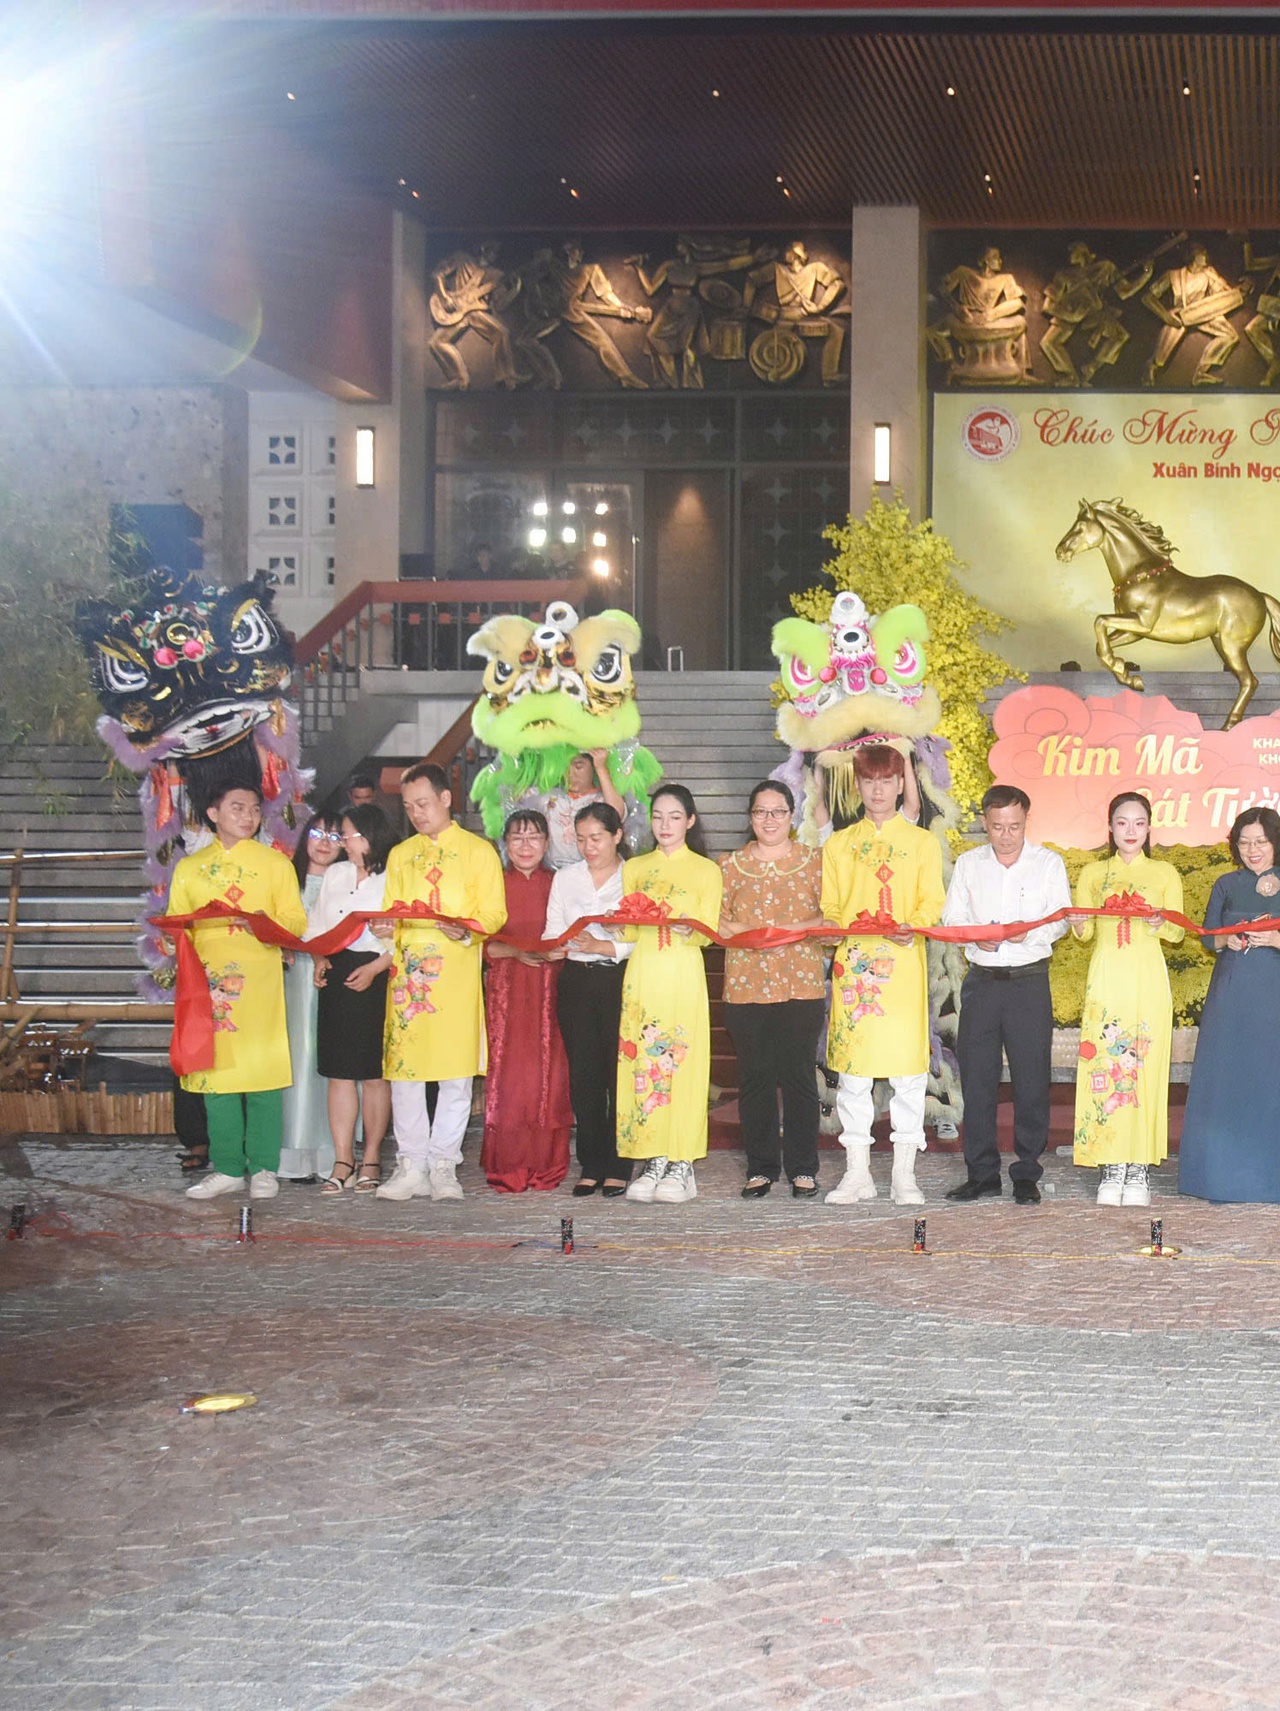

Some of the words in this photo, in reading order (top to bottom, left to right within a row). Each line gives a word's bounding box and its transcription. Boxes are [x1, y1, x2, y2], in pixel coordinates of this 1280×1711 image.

[1033, 407, 1115, 447] Chúc
[1122, 409, 1239, 460] Mừng
[1152, 462, 1198, 479] Xuân
[1204, 462, 1241, 479] Bính
[1037, 734, 1121, 776] Kim
[1135, 734, 1204, 776] Mã
[1137, 787, 1192, 829] át
